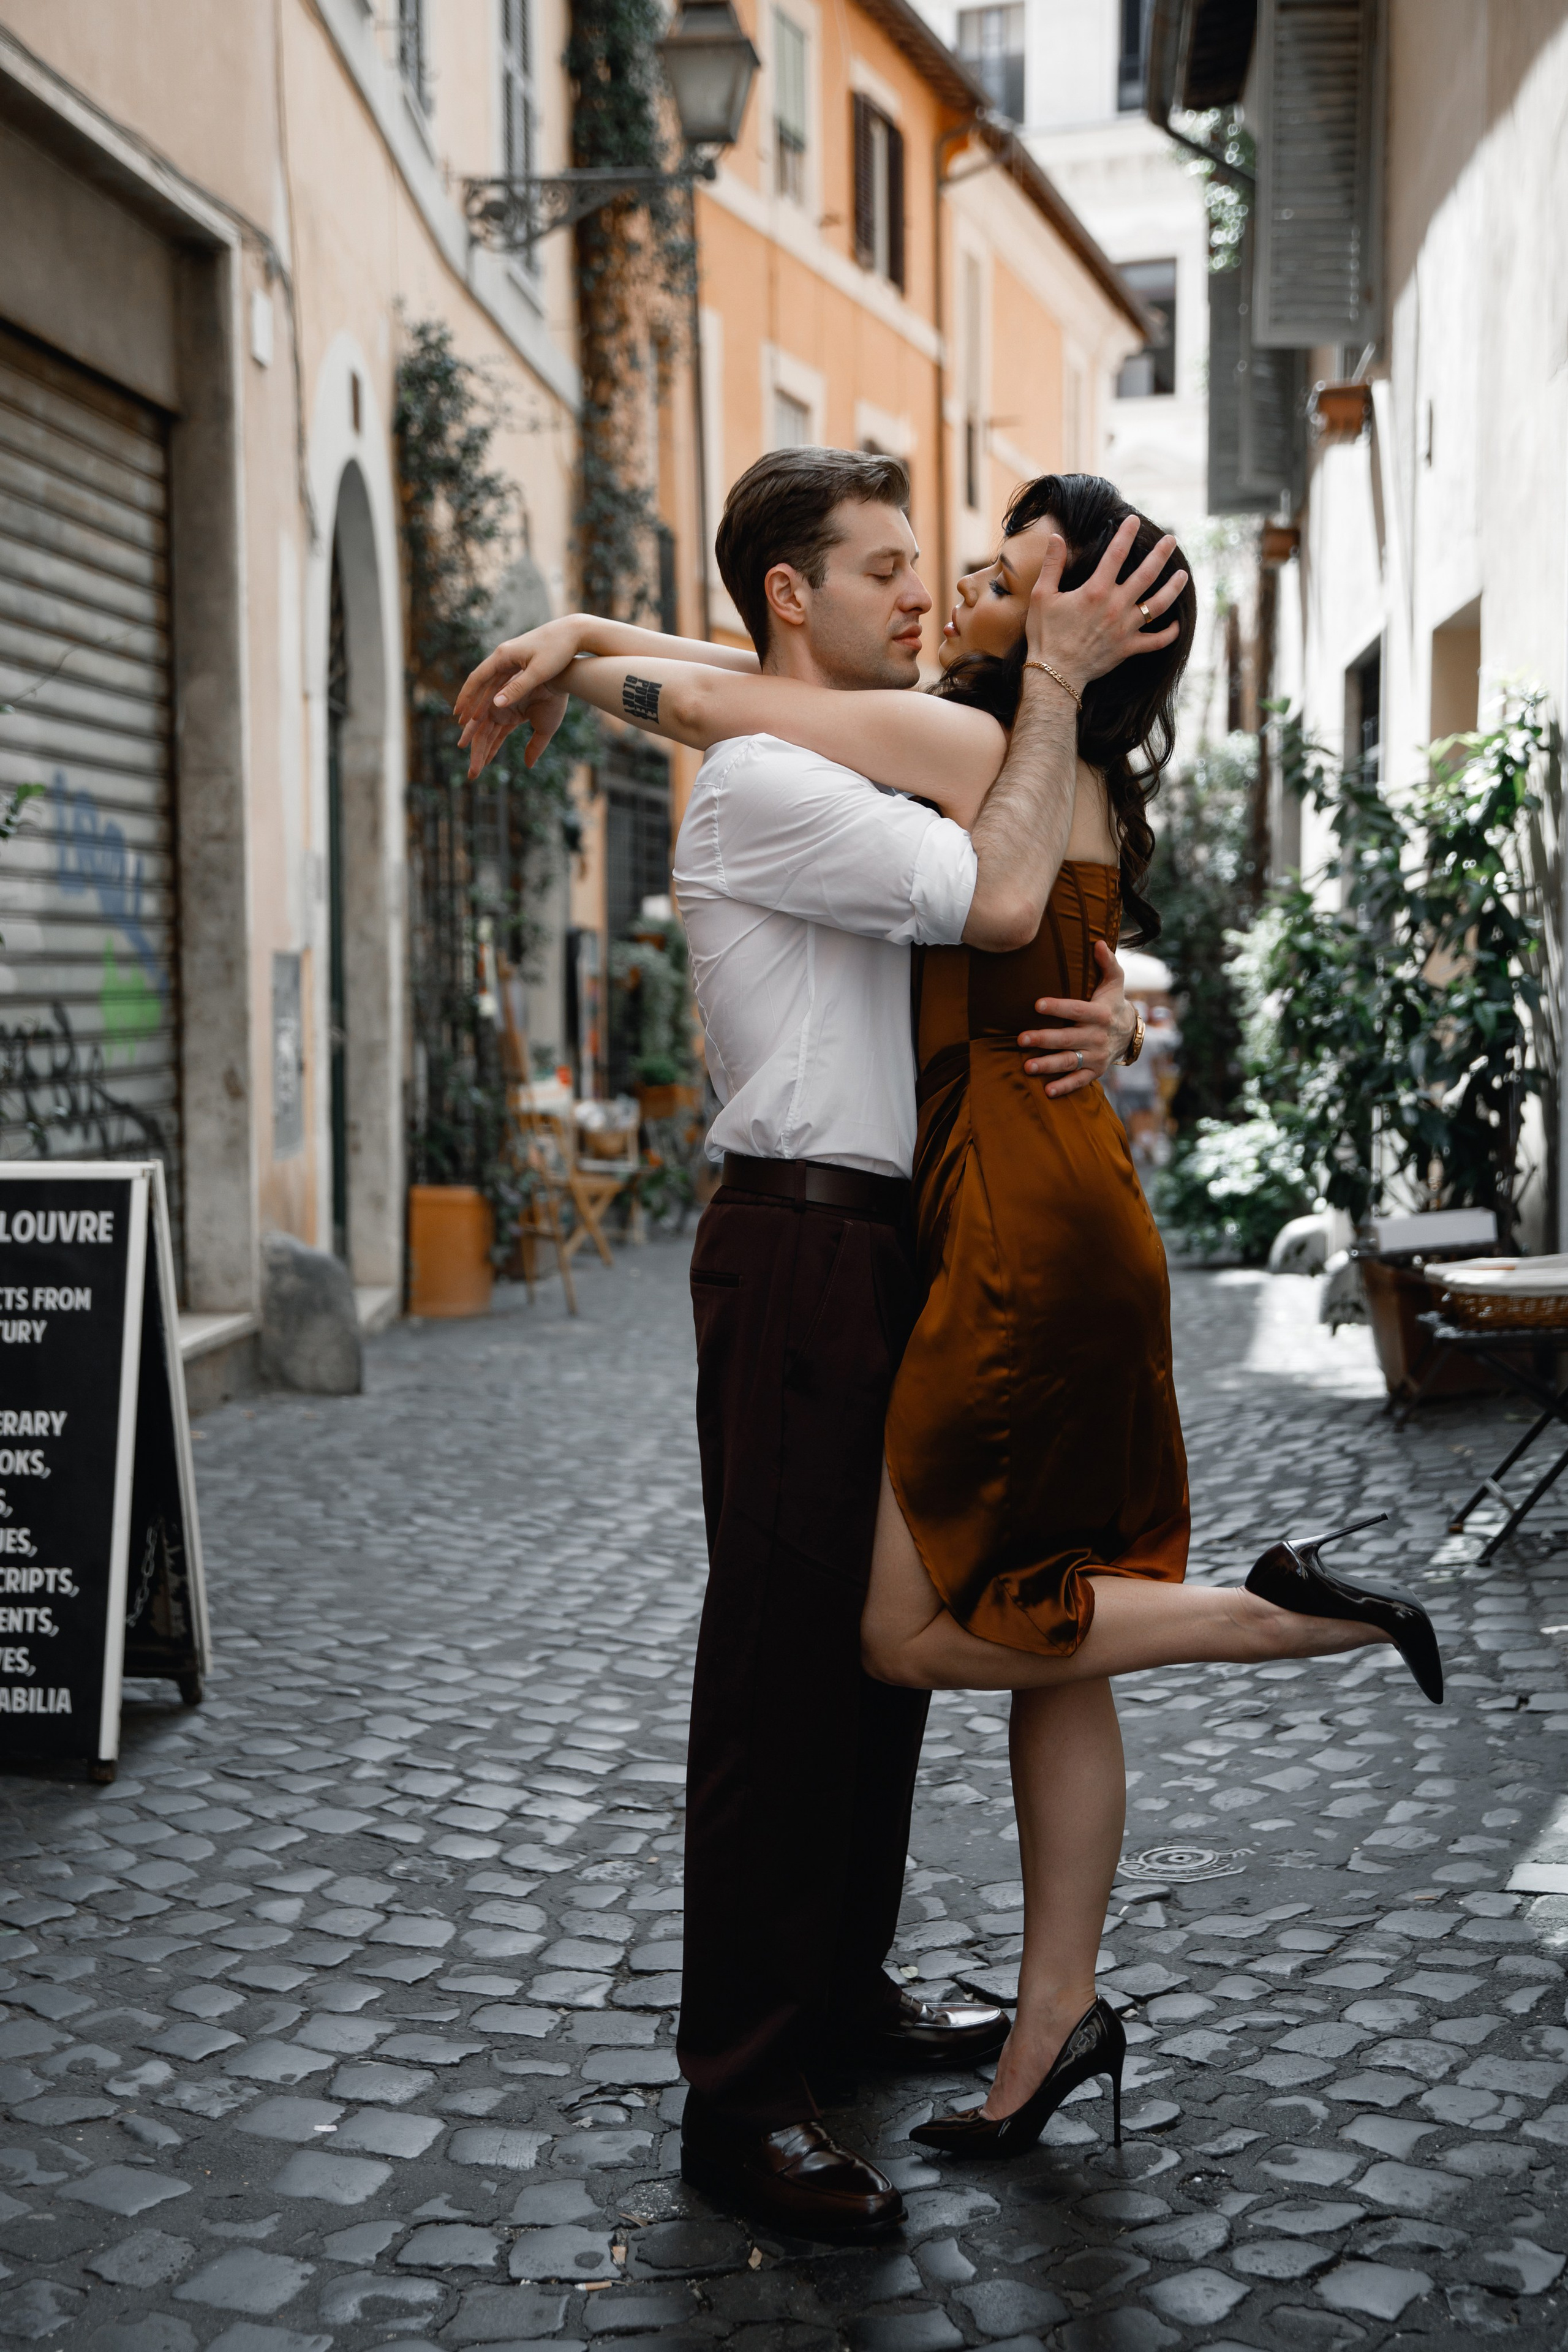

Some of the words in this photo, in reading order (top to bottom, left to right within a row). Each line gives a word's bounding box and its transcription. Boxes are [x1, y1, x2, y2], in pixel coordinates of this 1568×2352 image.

[0, 1210, 114, 1243] LOUVRE
[0, 1286, 29, 1310] TS
[32, 1286, 92, 1310] FROM
[0, 1646, 36, 1676] ES,
